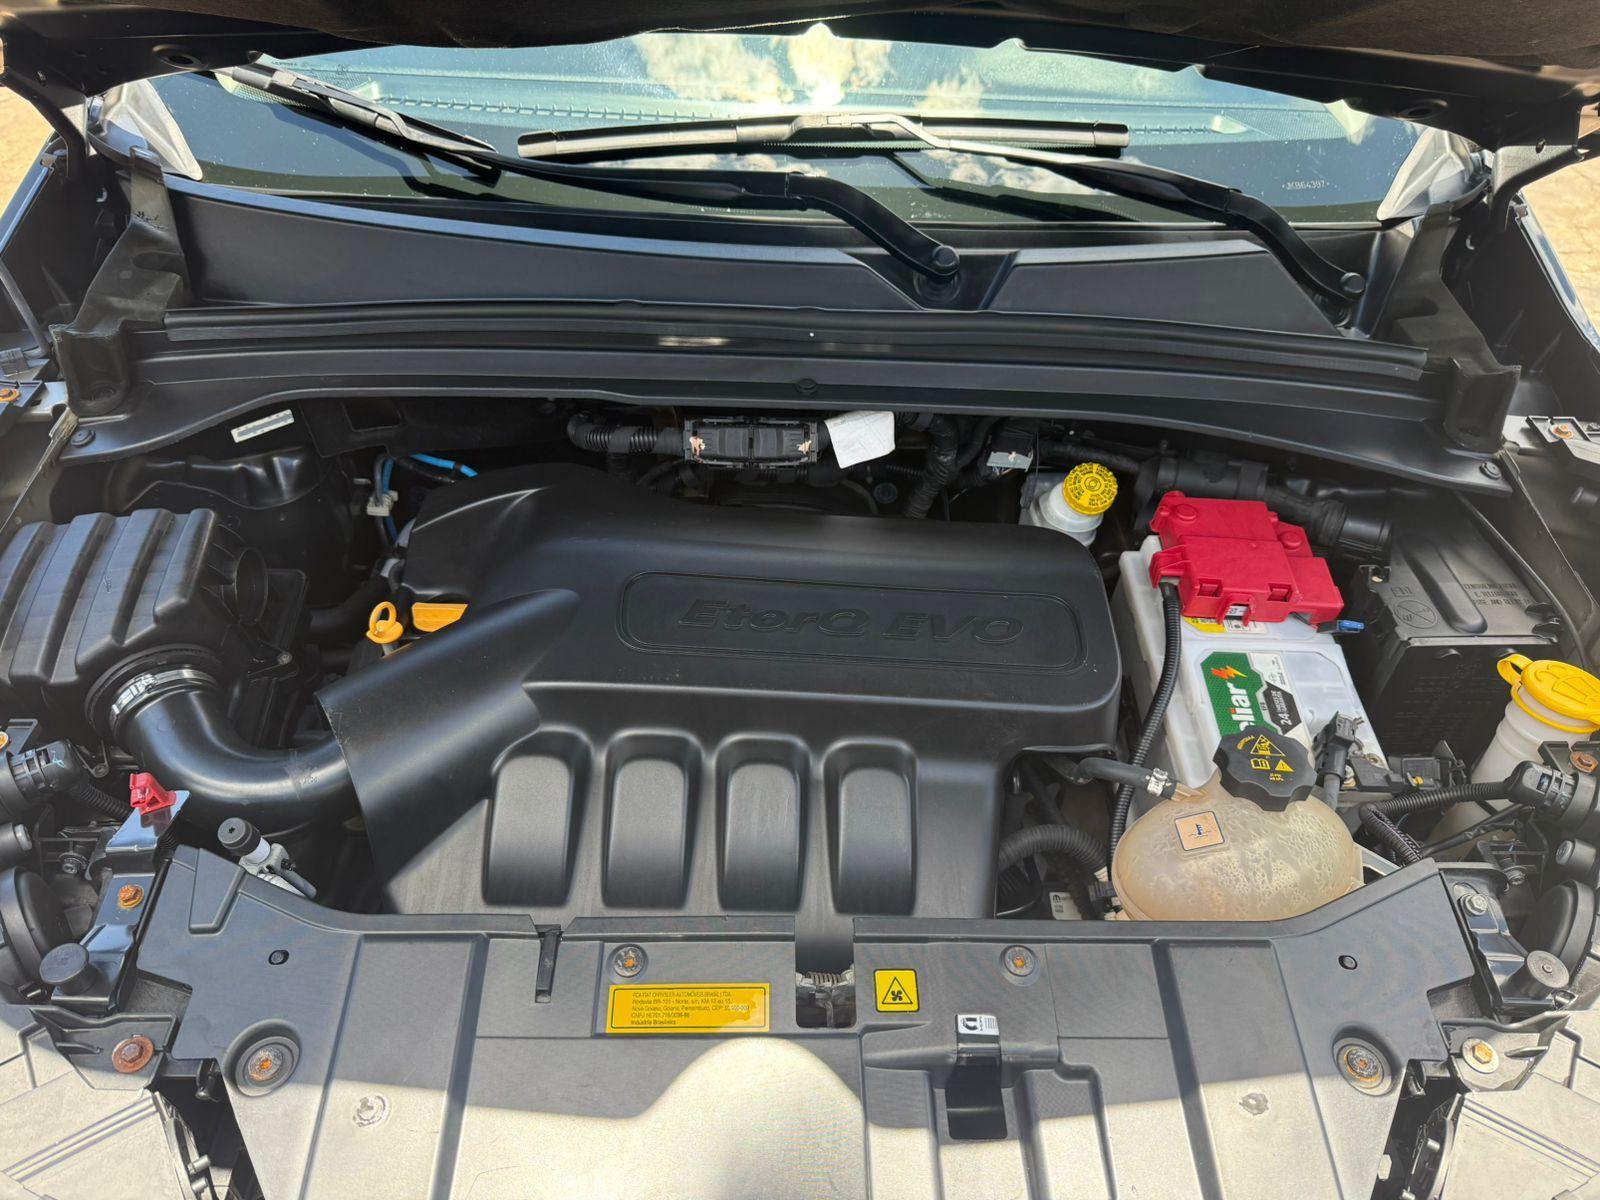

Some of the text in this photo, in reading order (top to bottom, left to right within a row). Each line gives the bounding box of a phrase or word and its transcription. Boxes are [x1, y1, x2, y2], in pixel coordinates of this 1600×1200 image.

[678, 599, 1024, 645] EtorQ EVO
[1278, 713, 1292, 725] 24
